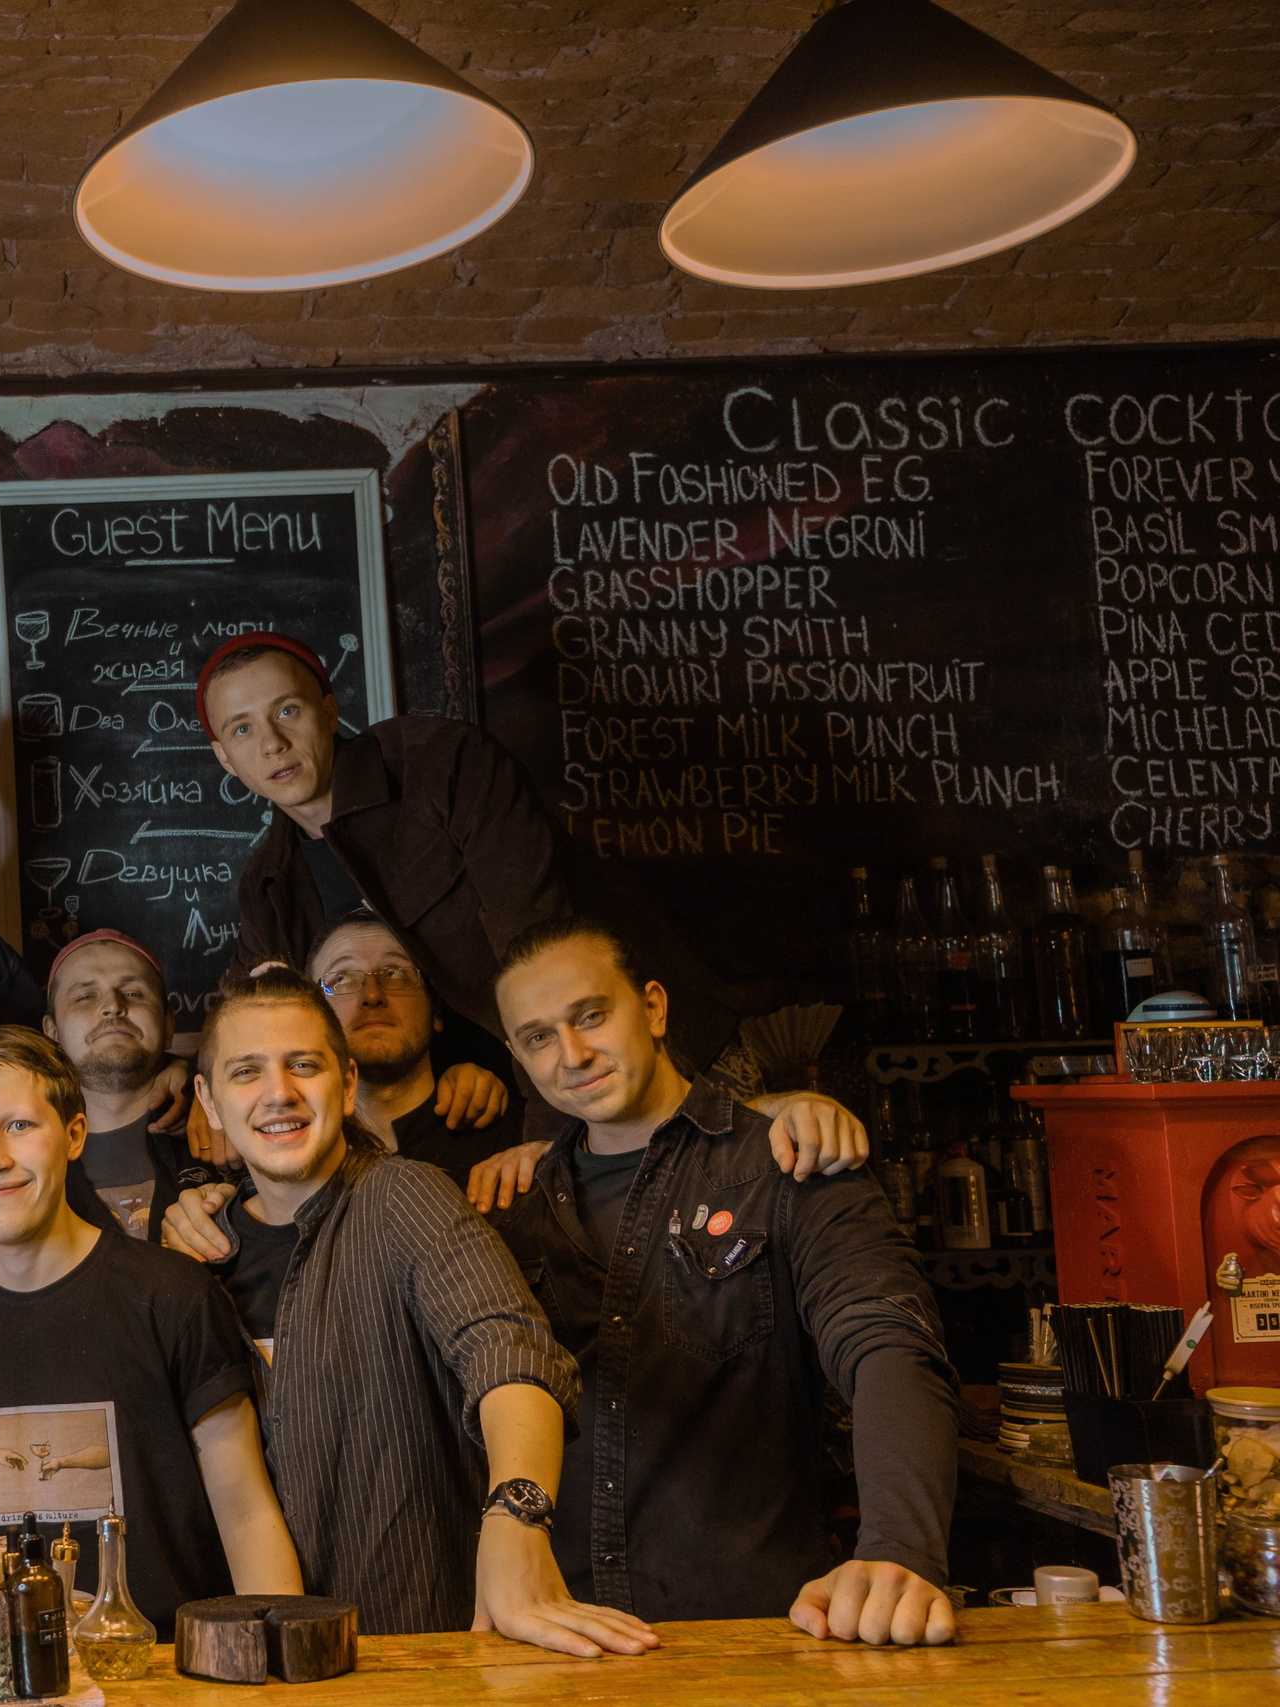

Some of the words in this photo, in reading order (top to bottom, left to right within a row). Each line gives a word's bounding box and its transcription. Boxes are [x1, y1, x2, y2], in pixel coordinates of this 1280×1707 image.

[548, 454, 619, 506] OLD
[629, 452, 841, 505] FASHIONED
[1085, 451, 1257, 502] FOREVER
[51, 507, 188, 557] Guest
[207, 502, 321, 554] Menu
[552, 508, 745, 565] LAVENDER
[768, 505, 926, 560] NEGRONI
[1092, 506, 1197, 556] BASIL
[548, 565, 837, 612] GRASSHOPPER
[1096, 556, 1275, 605] POPCORN
[64, 607, 179, 647] Вечные
[551, 615, 727, 660] GRANNY
[743, 612, 870, 657] SMITH
[1098, 605, 1188, 655] PINA
[558, 659, 721, 706] DAIQUIRI
[747, 658, 985, 704] PASSIONFRUIT
[1102, 657, 1209, 703] APPLE
[148, 701, 205, 734] Оле
[561, 709, 695, 763] FOREST
[717, 706, 808, 759] MILK
[827, 710, 960, 760] PUNCH
[70, 763, 203, 812] Хозяйка
[559, 763, 818, 813] STRAWBERRY
[831, 760, 917, 804] MILK
[931, 759, 1062, 809] PUNCH
[724, 809, 785, 855] PIE
[1110, 801, 1272, 850] CHERRY
[77, 848, 232, 901] Девушка
[1241, 1290, 1269, 1298] MARTINI
[45, 1512, 79, 1520] culture
